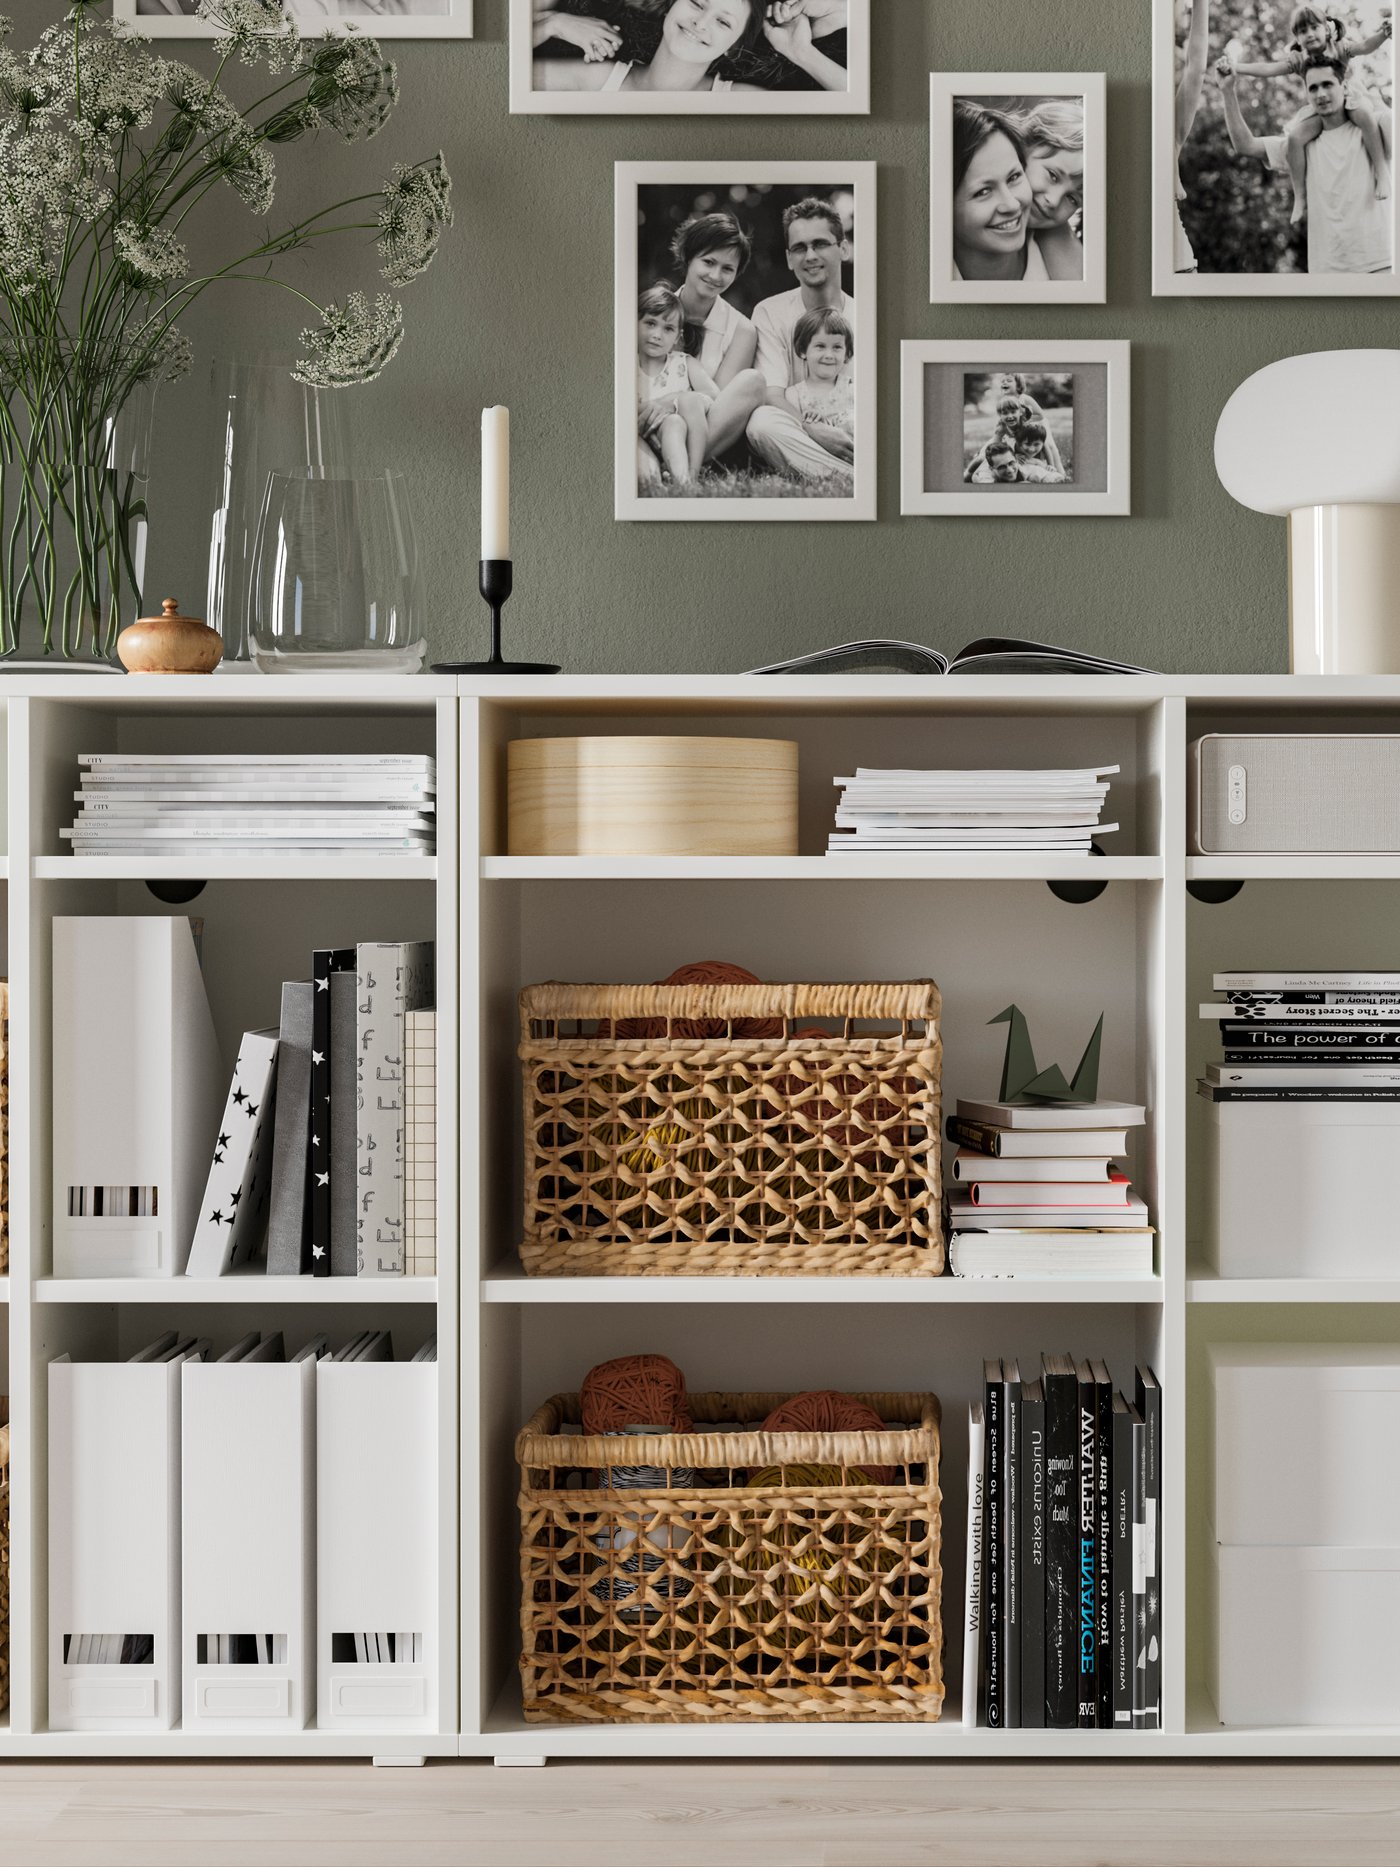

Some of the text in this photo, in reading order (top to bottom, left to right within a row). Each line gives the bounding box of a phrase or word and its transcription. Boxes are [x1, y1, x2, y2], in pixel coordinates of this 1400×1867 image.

[1347, 996, 1377, 1005] Theory
[1285, 1006, 1316, 1016] Story
[1318, 1008, 1355, 1016] Secret
[1357, 1008, 1379, 1016] The
[1247, 1031, 1287, 1043] The
[1294, 1034, 1358, 1047] power
[1365, 1032, 1390, 1044] of
[968, 1473, 984, 1632] Walking with love
